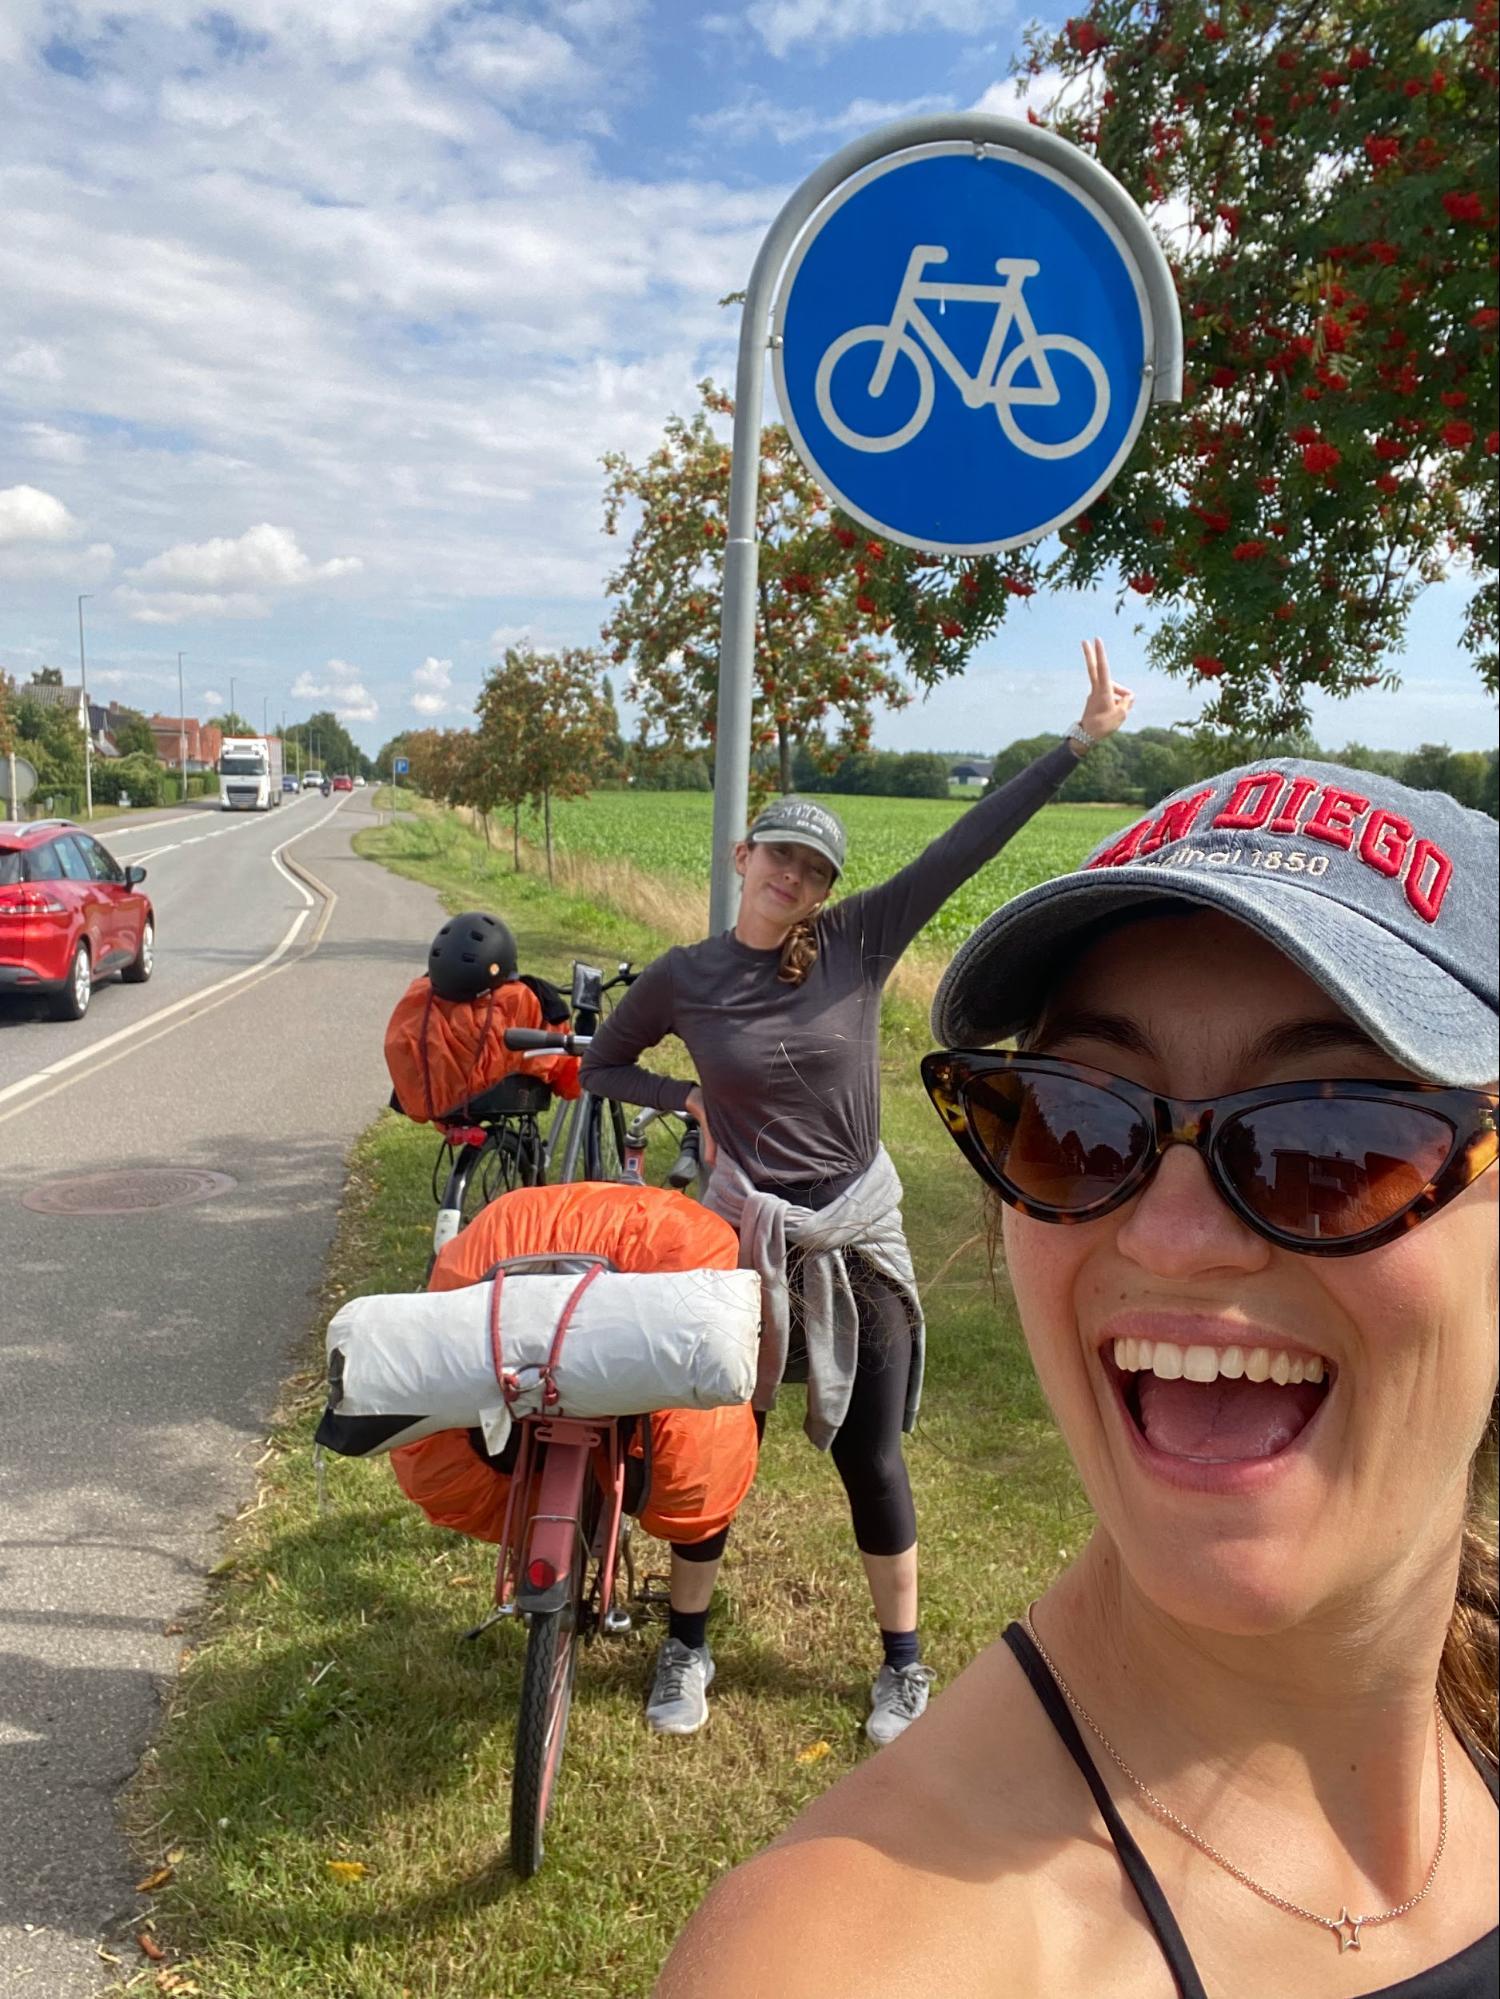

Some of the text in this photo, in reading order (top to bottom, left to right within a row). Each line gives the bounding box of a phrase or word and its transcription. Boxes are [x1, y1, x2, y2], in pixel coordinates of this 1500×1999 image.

[397, 760, 406, 772] P
[1211, 771, 1453, 924] DIEGO
[1251, 849, 1330, 876] 1850
